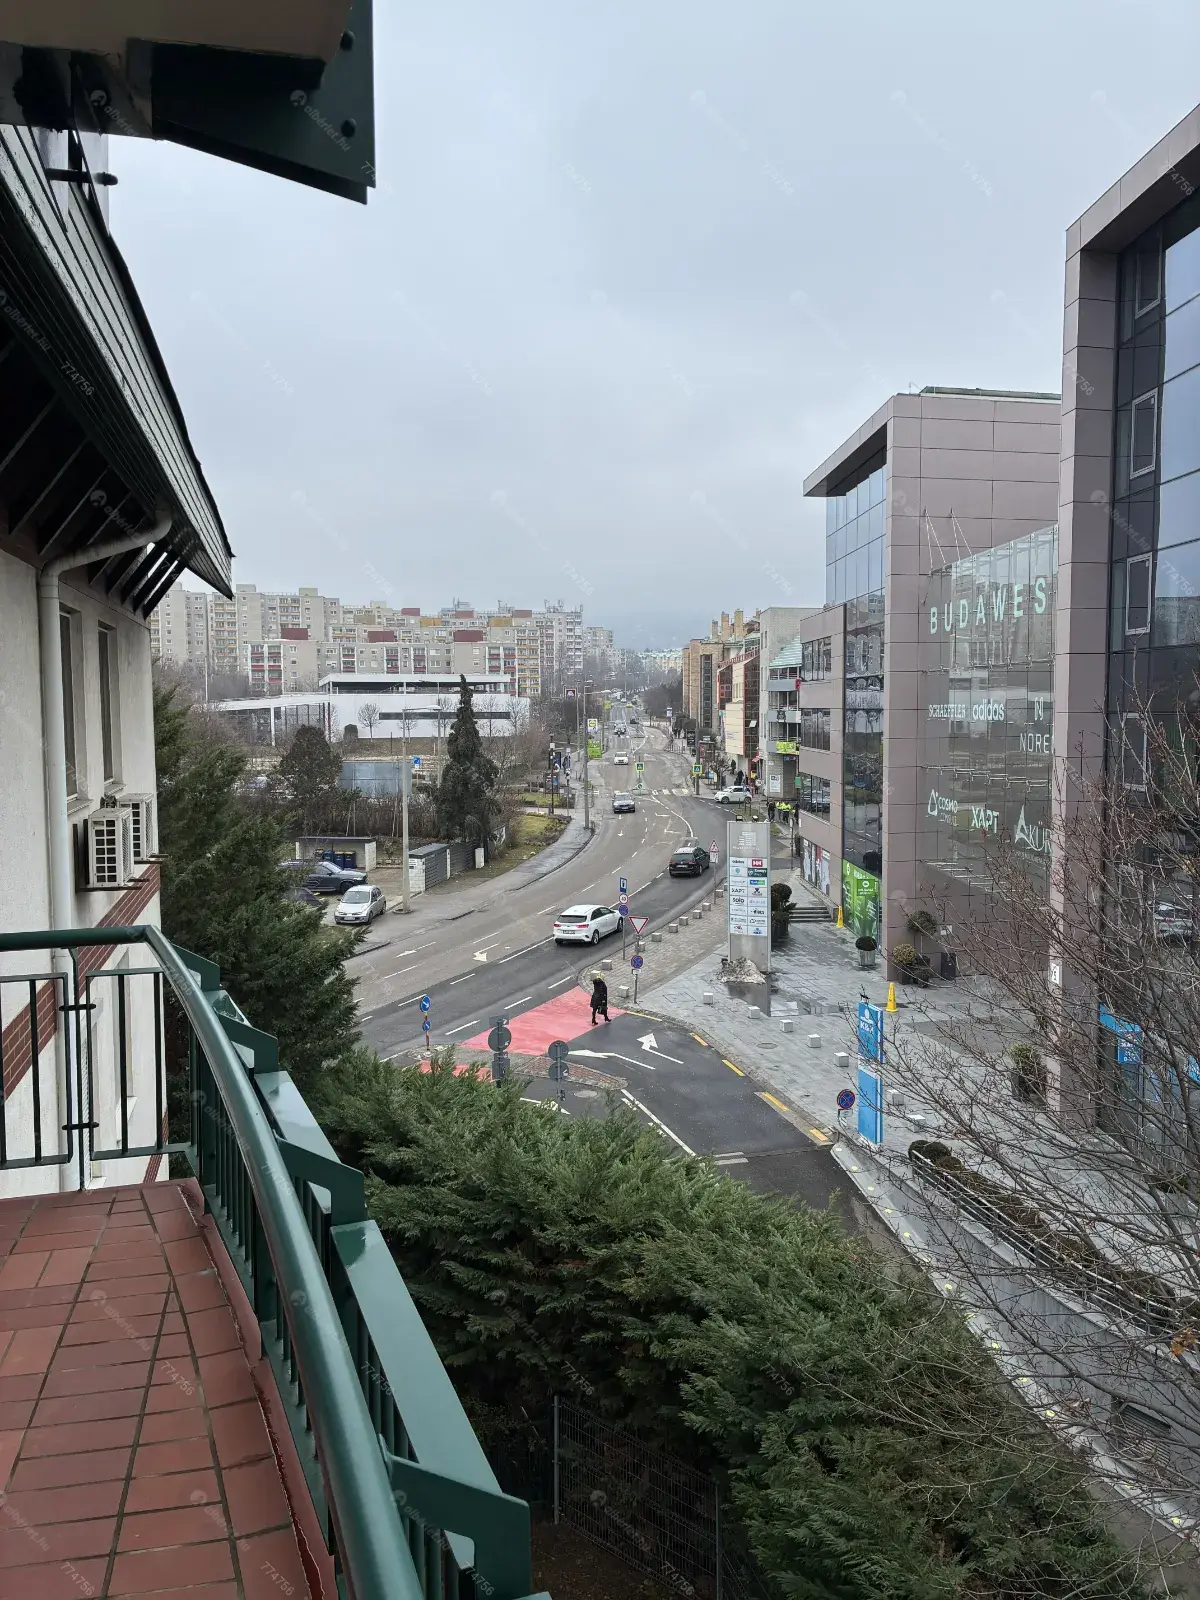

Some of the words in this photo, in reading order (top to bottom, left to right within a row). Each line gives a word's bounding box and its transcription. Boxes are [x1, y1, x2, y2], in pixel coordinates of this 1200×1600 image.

[929, 577, 1047, 635] BUDAWES
[972, 698, 1005, 721] adidas
[938, 796, 958, 814] COSMO
[971, 805, 1000, 834] XAPT
